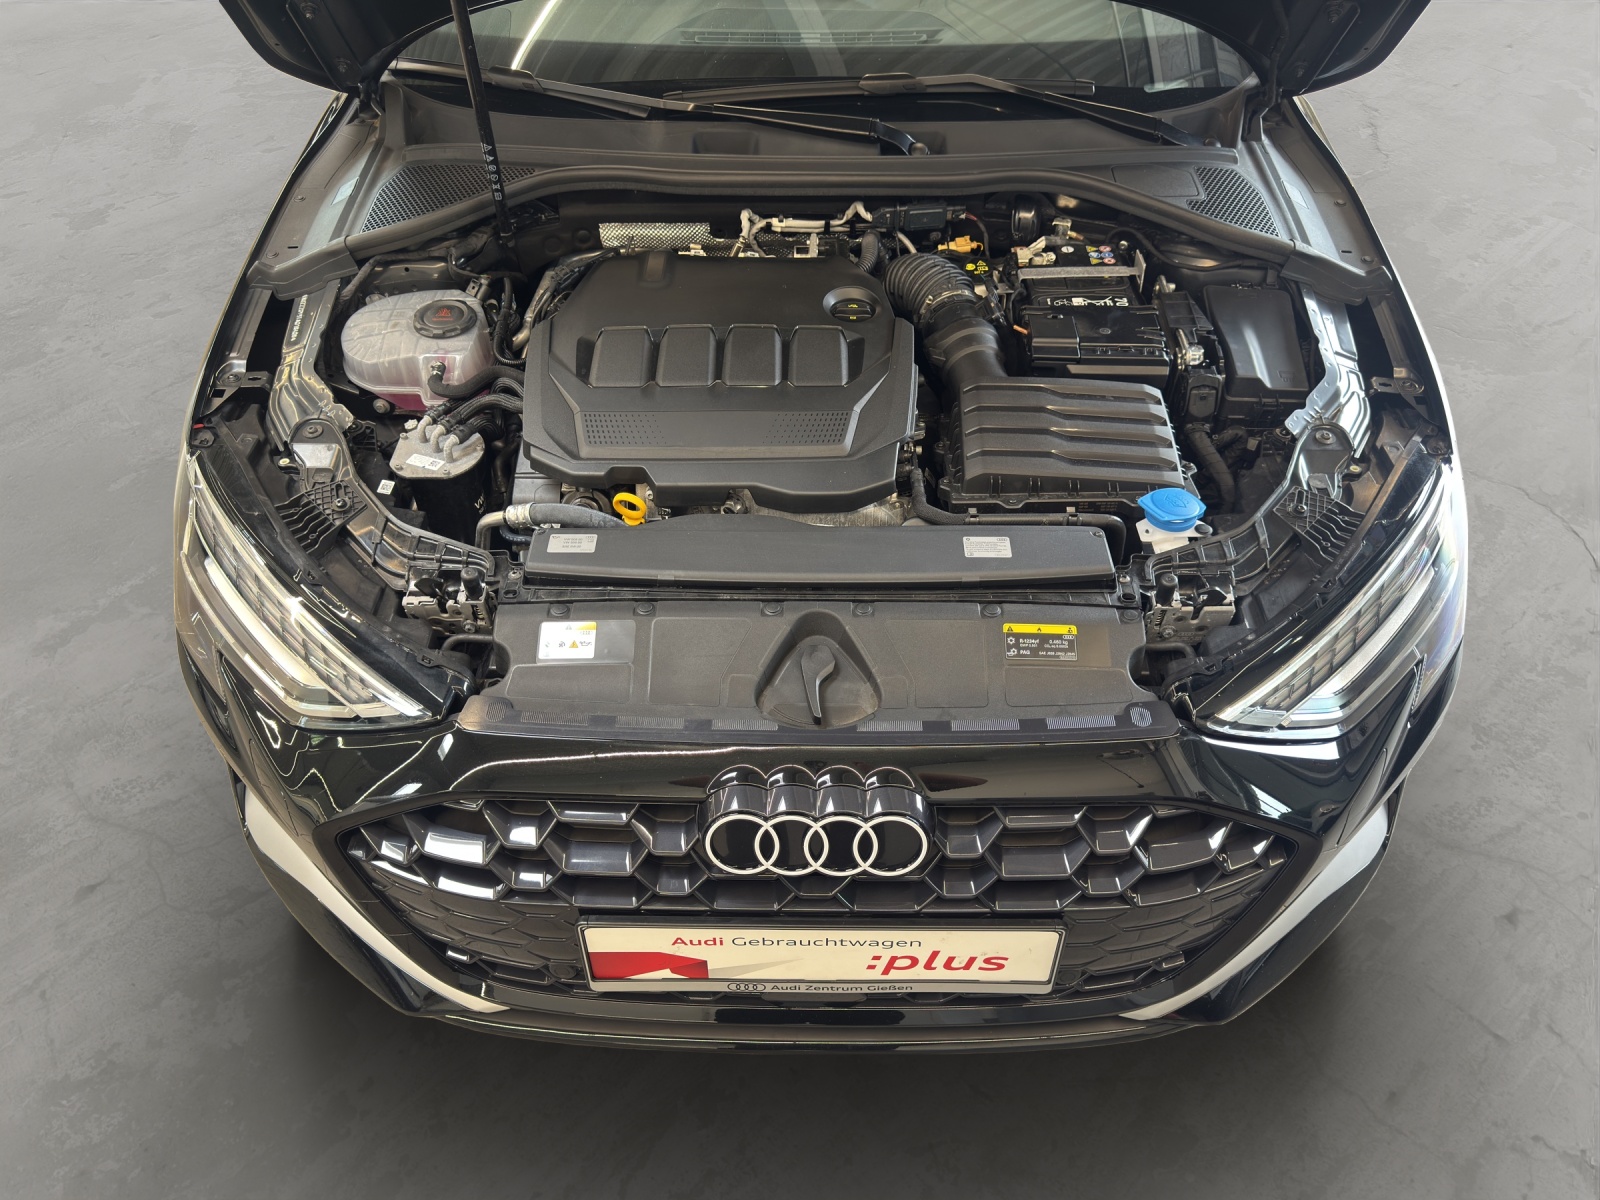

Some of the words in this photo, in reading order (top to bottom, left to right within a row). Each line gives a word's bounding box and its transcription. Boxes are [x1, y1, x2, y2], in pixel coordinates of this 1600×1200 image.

[671, 936, 724, 946] Audi
[731, 936, 922, 950] Gebrauchtwagen
[804, 984, 863, 992] Zentrum
[867, 984, 913, 992] Gießen
